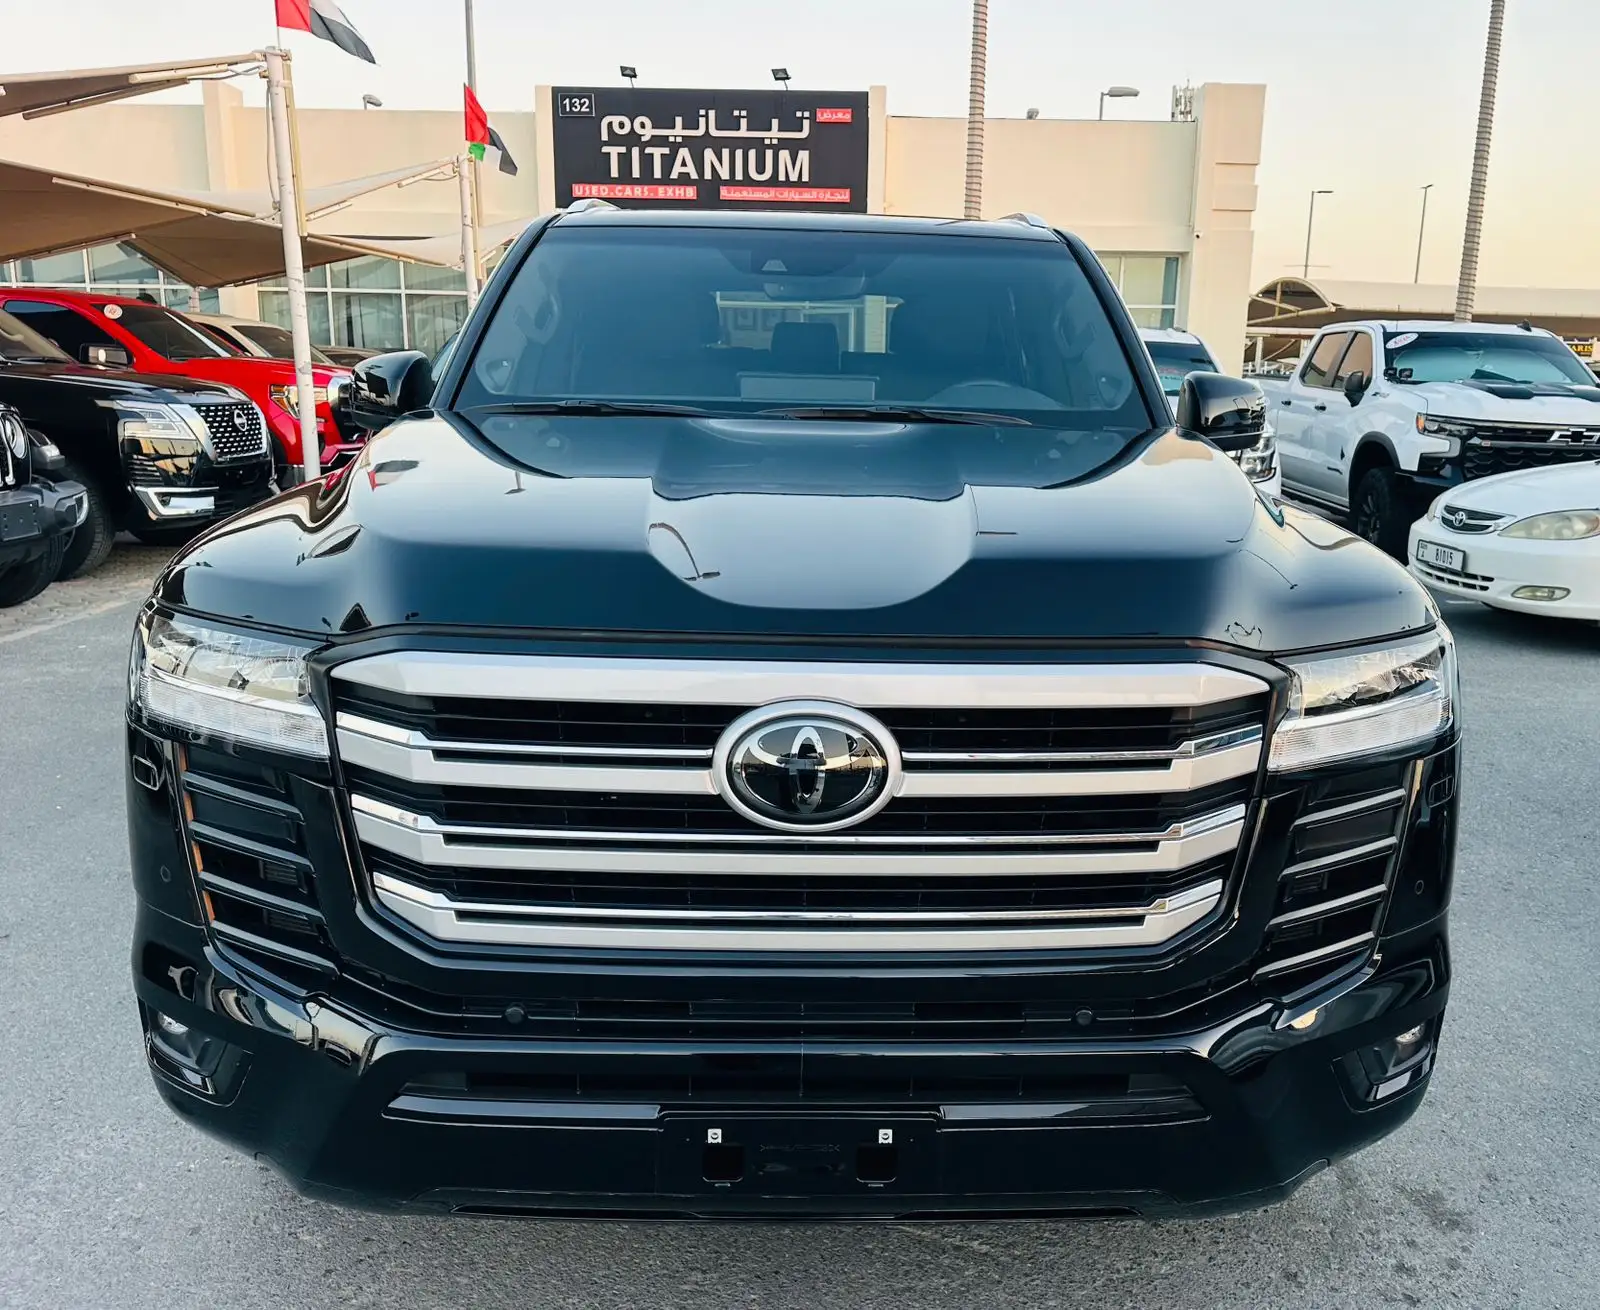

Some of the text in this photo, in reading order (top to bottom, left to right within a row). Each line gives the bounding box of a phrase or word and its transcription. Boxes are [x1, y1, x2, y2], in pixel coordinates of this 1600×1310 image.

[562, 97, 590, 112] 132
[817, 109, 851, 121] معرض
[600, 109, 811, 145] تيتانيوم
[601, 145, 810, 182] TITANIUM
[658, 185, 694, 197] EXHB
[776, 189, 817, 200] السيارات
[1435, 548, 1454, 565] 81015
